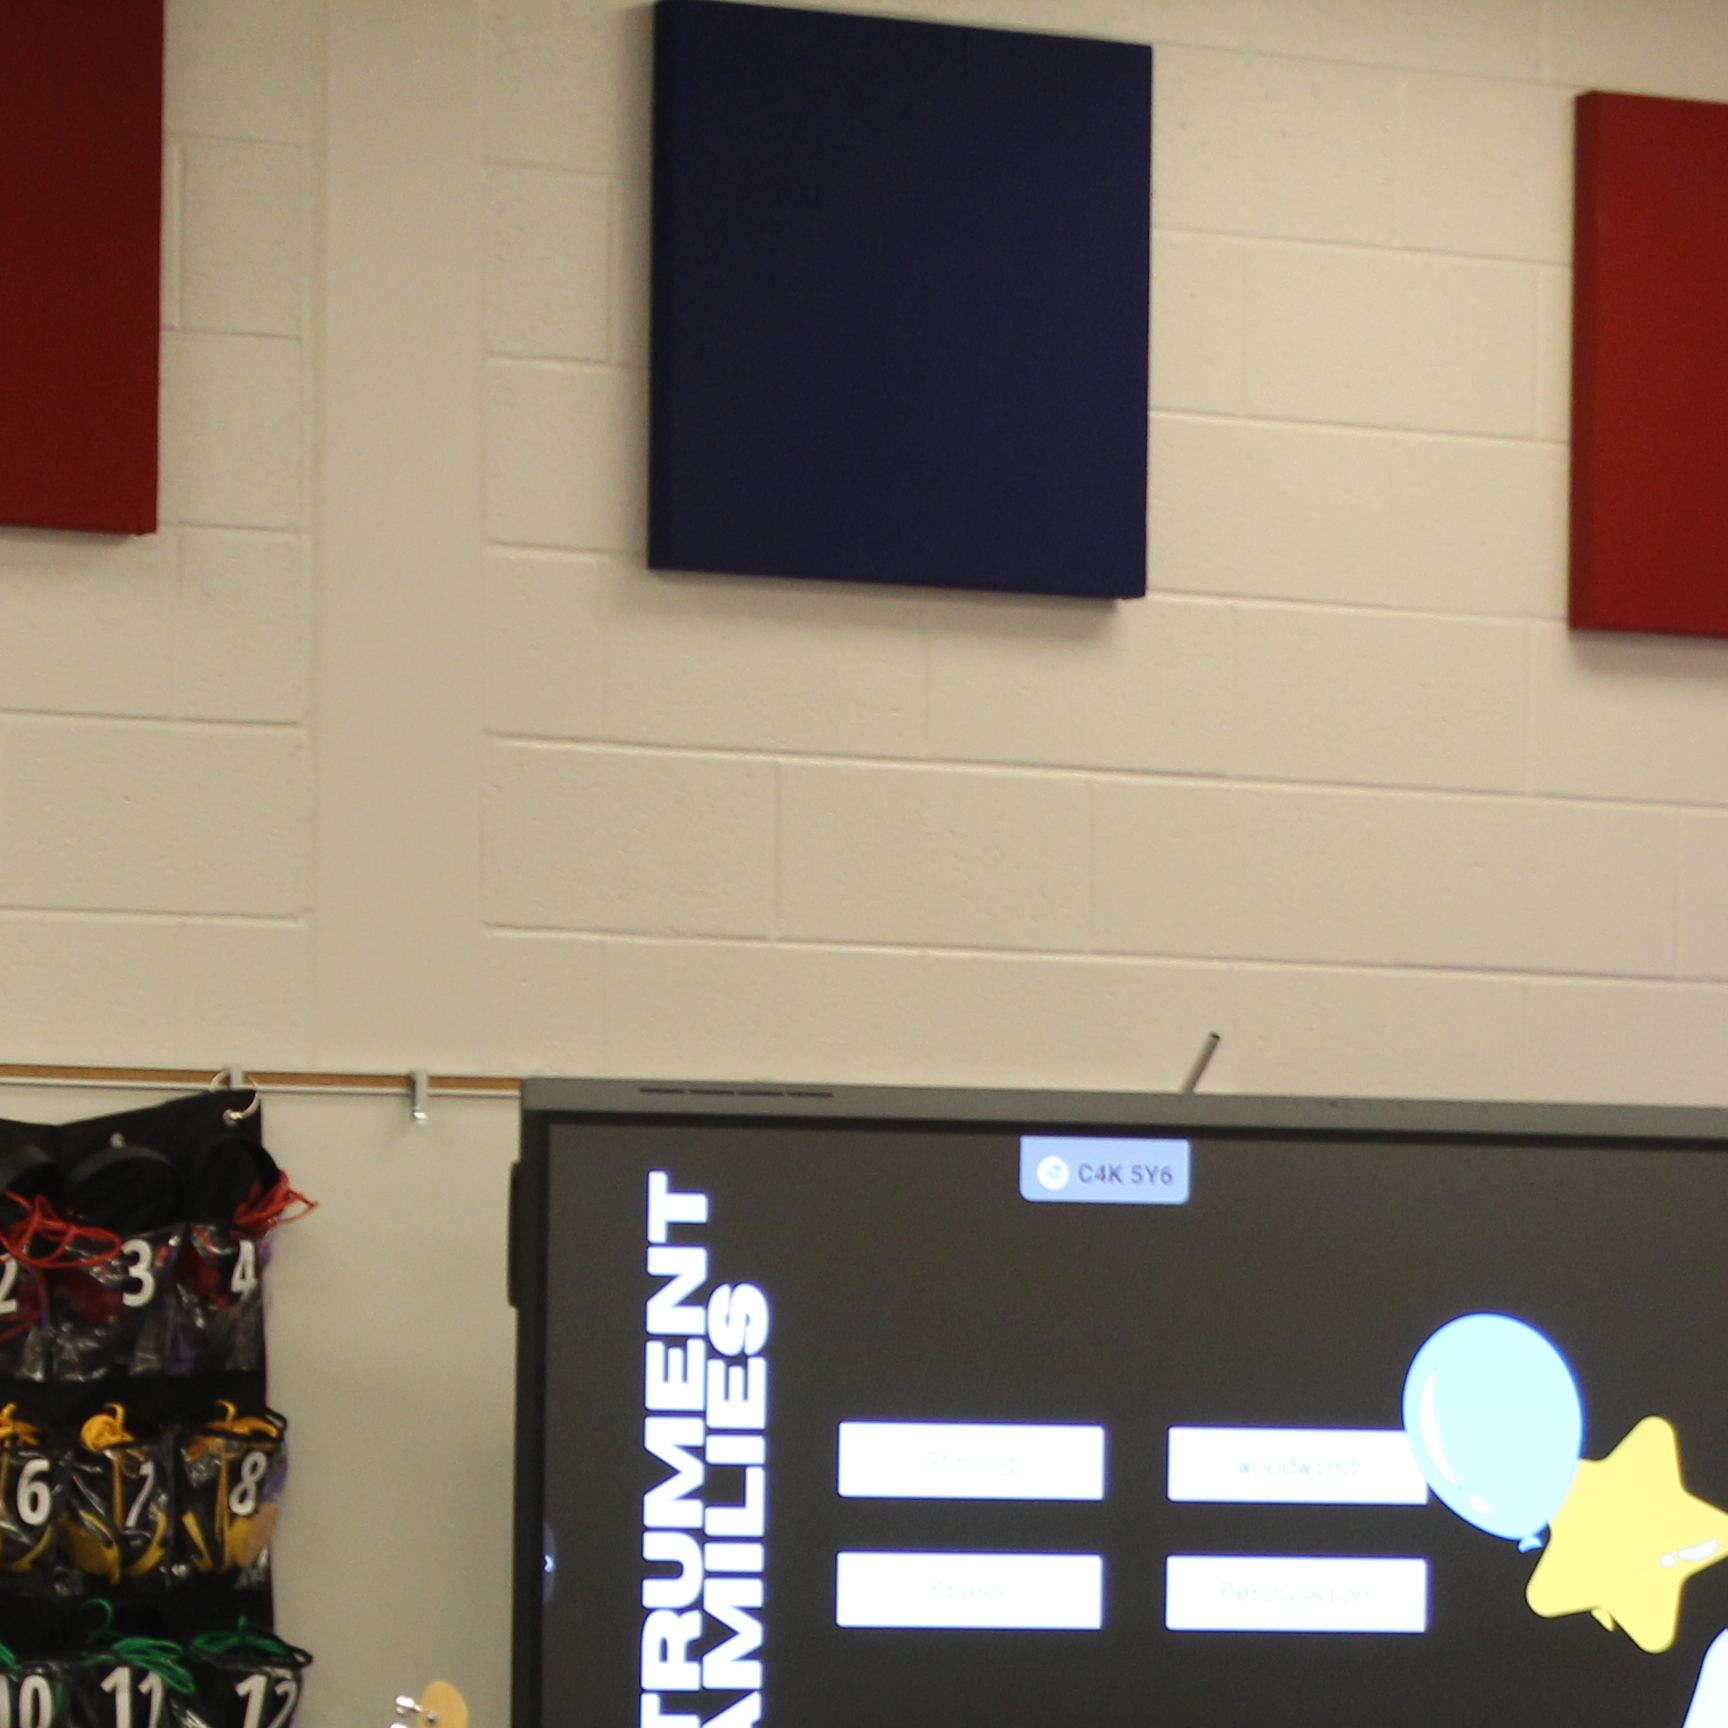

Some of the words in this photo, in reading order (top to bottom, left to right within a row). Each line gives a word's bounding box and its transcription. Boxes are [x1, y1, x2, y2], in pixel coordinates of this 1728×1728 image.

[1077, 1163, 1123, 1185] C4K
[1130, 1164, 1174, 1186] 5Y6
[121, 1238, 156, 1308] 3
[230, 1240, 257, 1296] 4
[228, 1451, 269, 1516] 8
[924, 1450, 1017, 1476] String
[1236, 1454, 1359, 1478] Woodwind
[16, 1458, 52, 1525] 6
[125, 1460, 155, 1528] 7
[930, 1579, 1007, 1601] Brass
[1220, 1582, 1372, 1604] Percussion
